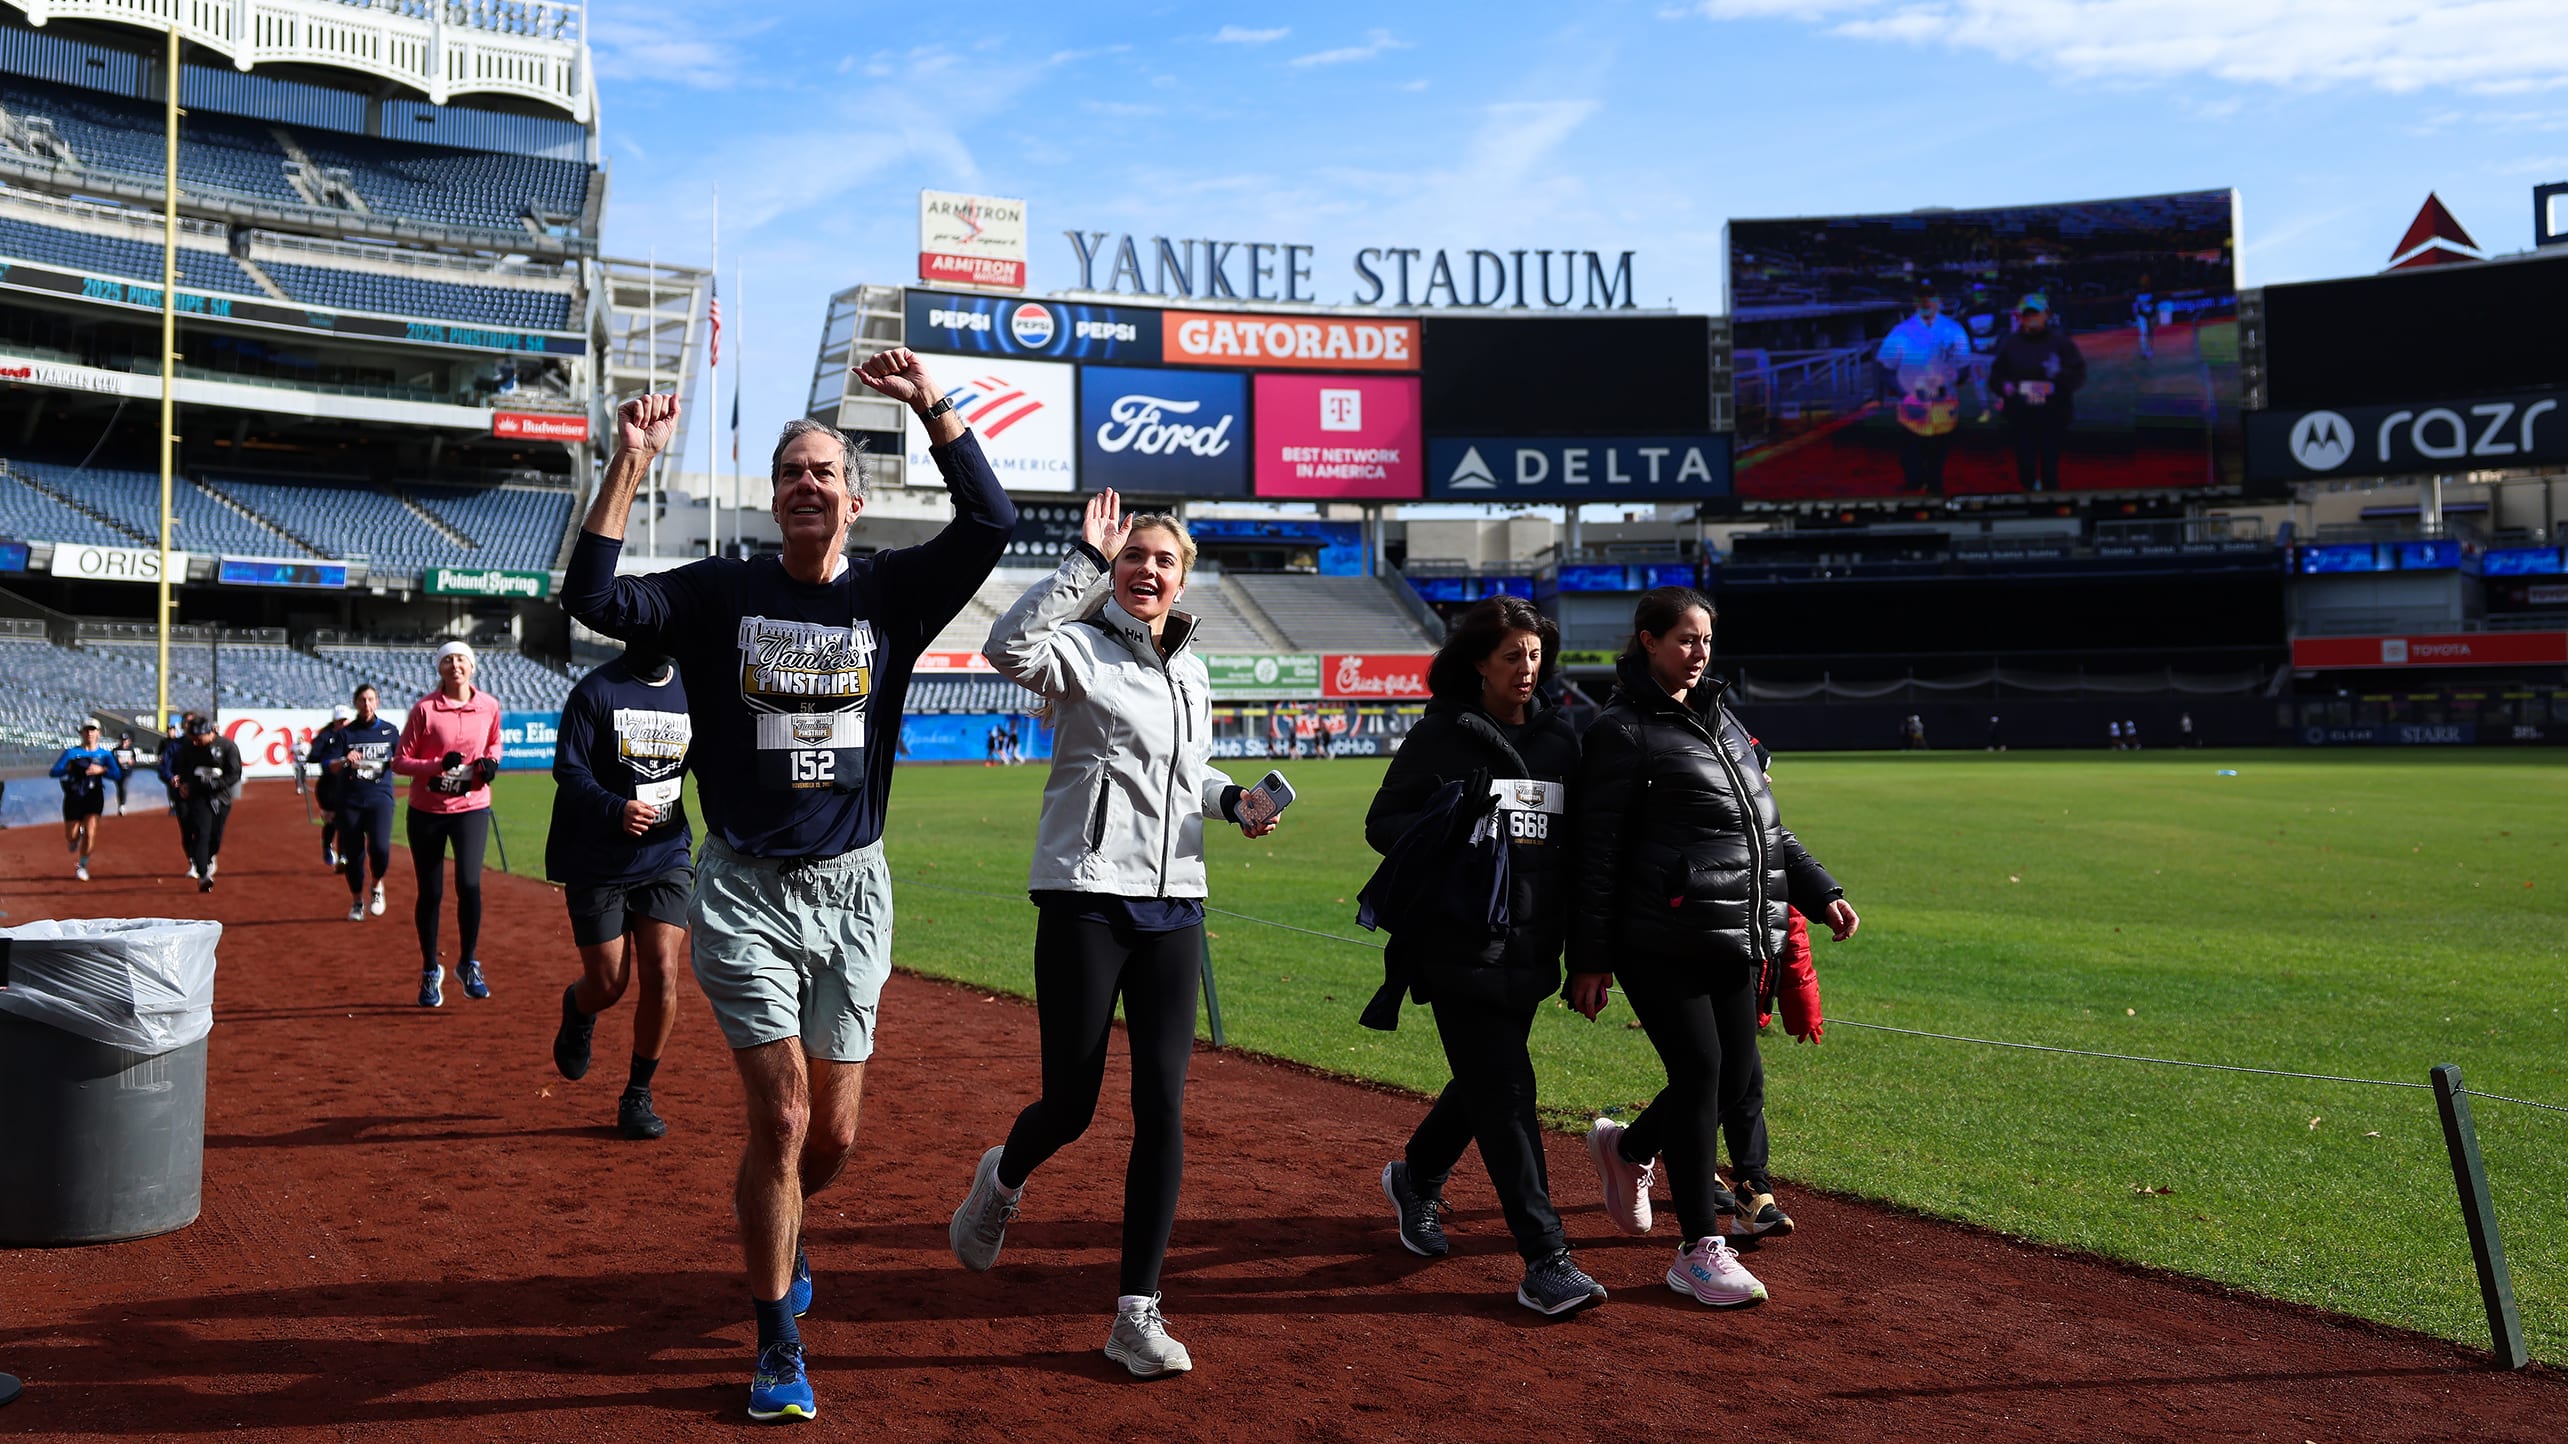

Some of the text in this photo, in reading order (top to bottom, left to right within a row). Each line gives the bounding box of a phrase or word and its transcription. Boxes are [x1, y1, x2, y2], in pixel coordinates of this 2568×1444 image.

[931, 255, 1017, 276] ARMITRON
[1064, 230, 1637, 310] YANKEE STADIUM
[82, 277, 123, 302] 2025
[929, 309, 991, 332] PEPSI
[1015, 319, 1051, 332] PEPSI
[1075, 320, 1136, 342] PEPSI
[405, 321, 443, 342] 2025
[449, 327, 520, 351] PINSTRIPE
[1177, 318, 1409, 361] GATORADE
[521, 418, 585, 437] Budweiser
[1096, 394, 1234, 457] Ford
[2378, 399, 2558, 462] razr
[991, 458, 1071, 473] AMERICA
[1281, 446, 1400, 465] BEST NETWORK
[1515, 447, 1713, 485] DELTA
[1296, 463, 1387, 480] IN AMERICA
[79, 549, 161, 577] ORIS
[437, 568, 539, 597] Poland Spring
[1124, 626, 1144, 643] HH
[754, 634, 860, 682] Yankees
[2412, 643, 2472, 657] TOYOTA
[757, 670, 861, 696] PINSTRIPE
[800, 702, 816, 714] 5K
[627, 720, 687, 750] Yankees
[630, 741, 685, 759] PINSTRIPE
[649, 760, 659, 769] 5K
[790, 750, 835, 781] 152
[1509, 811, 1548, 840] 668
[1689, 1262, 1712, 1284] HOKA
